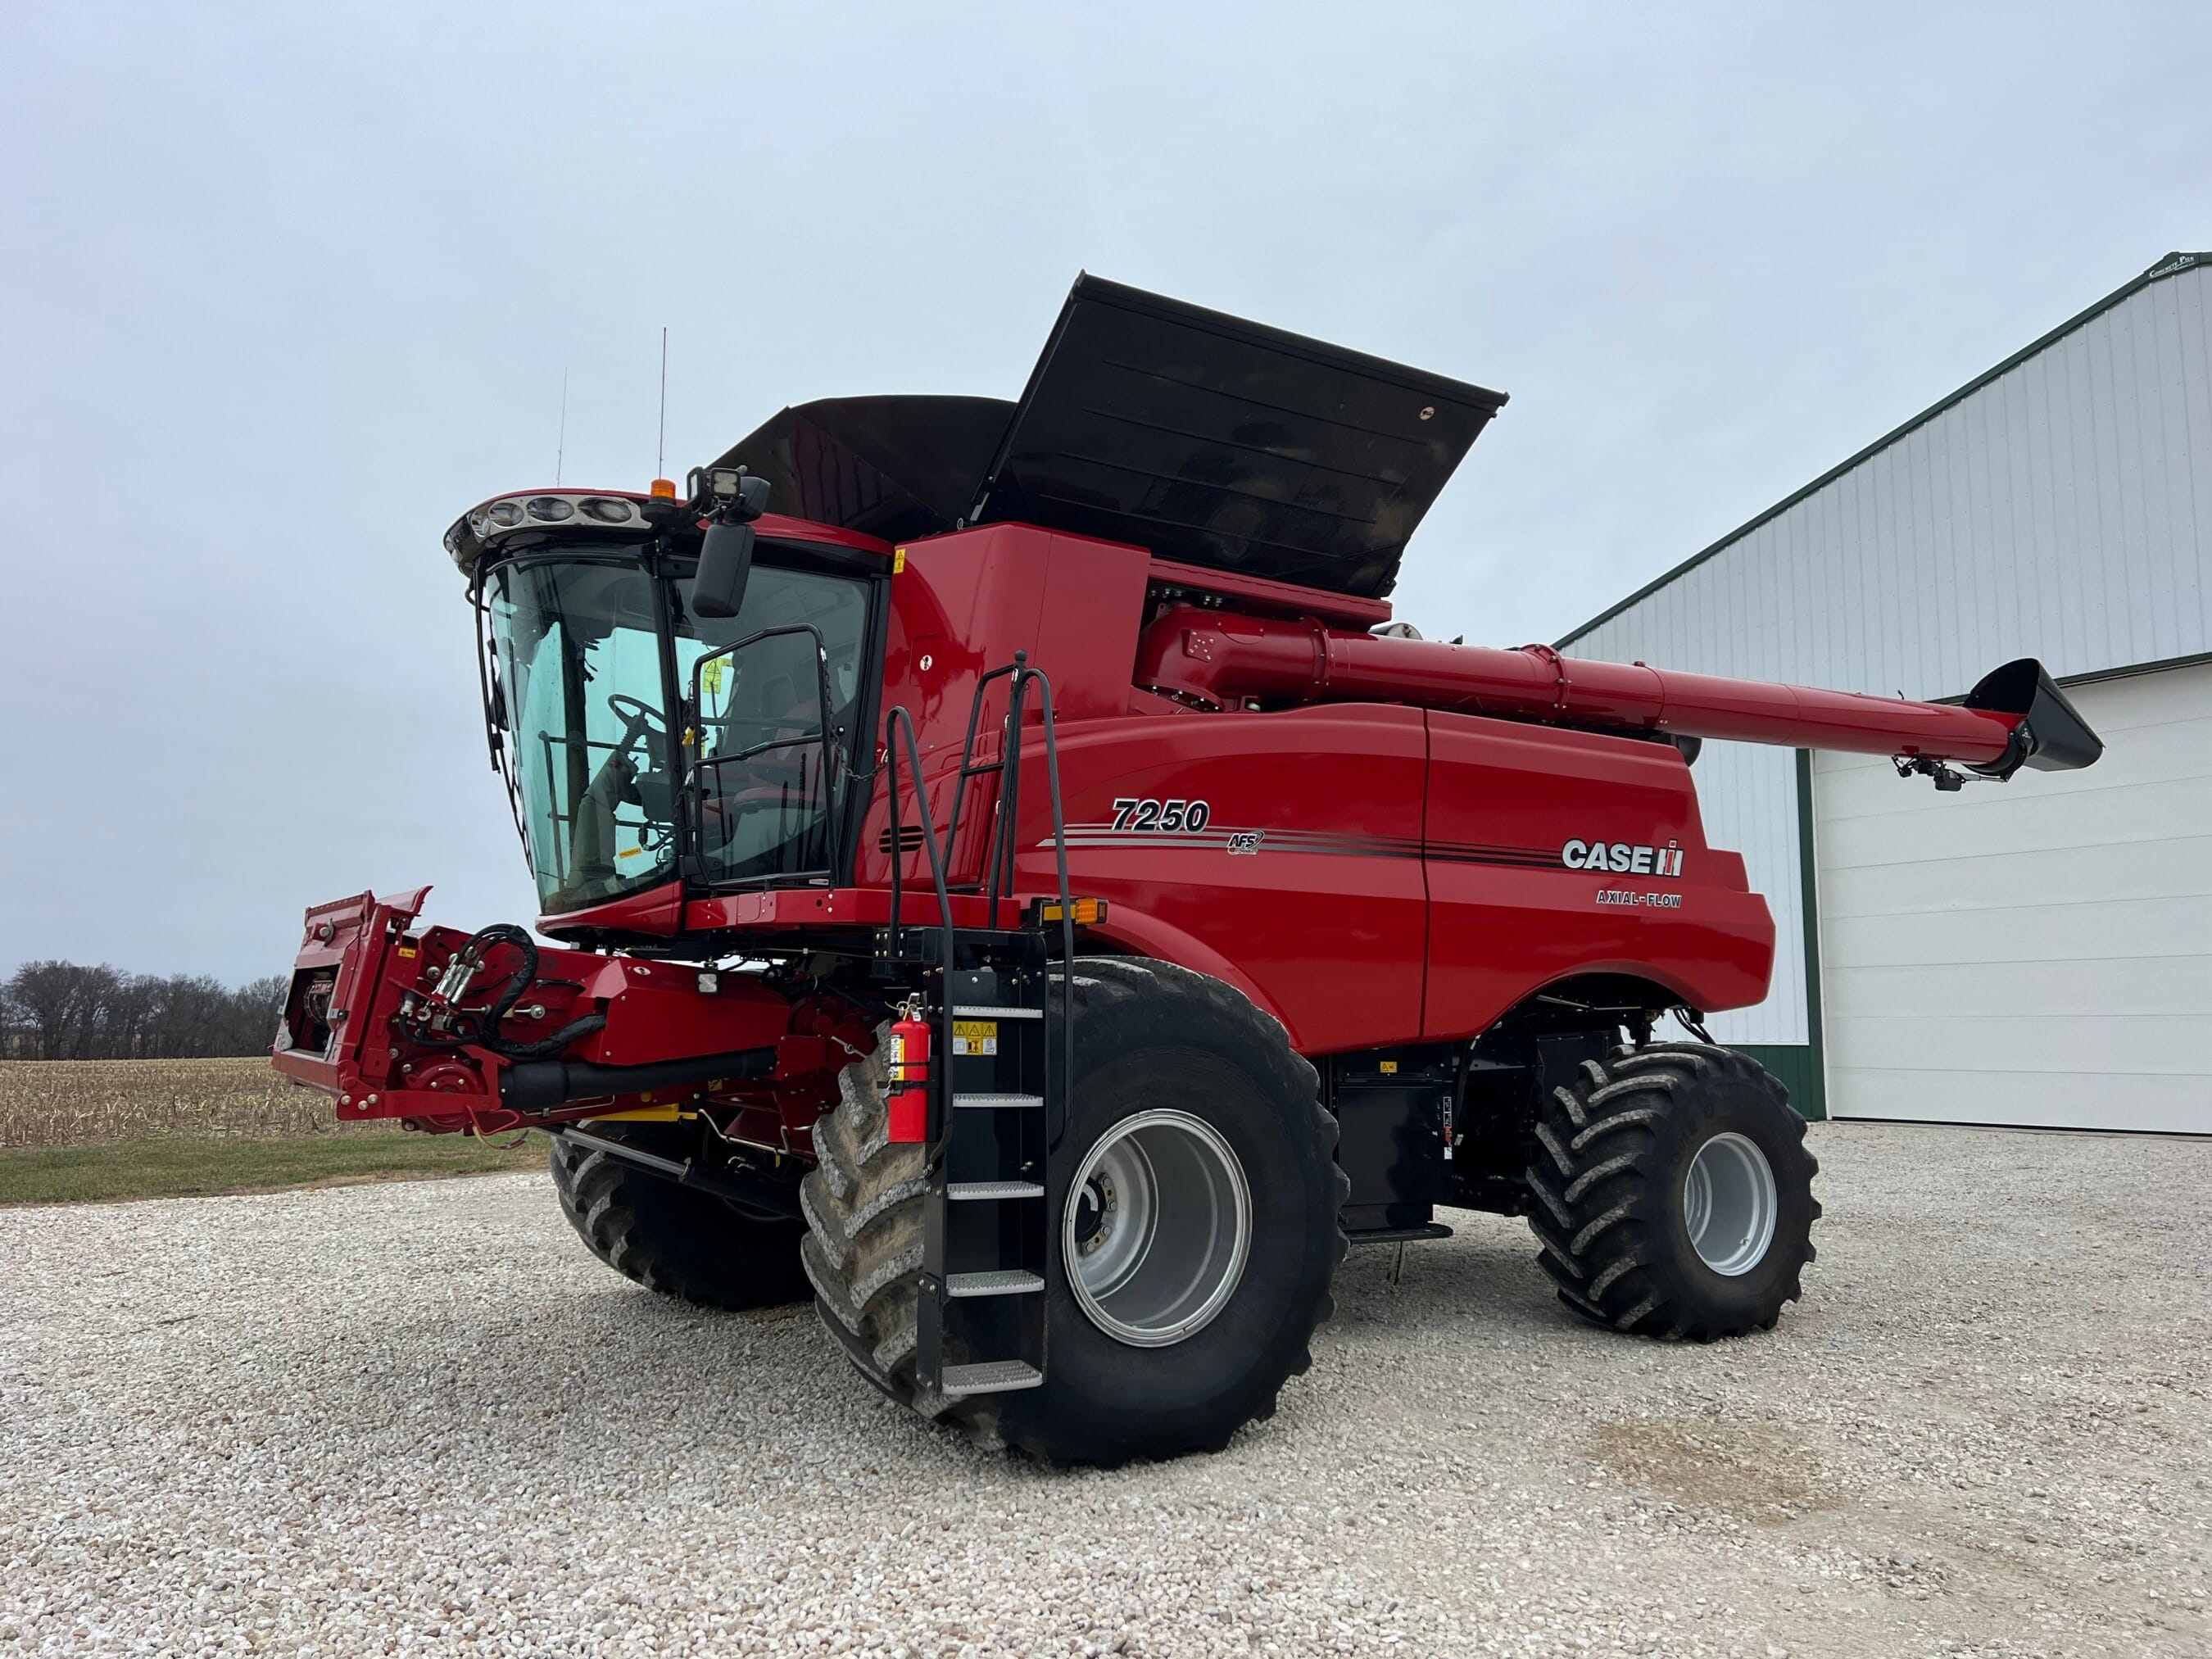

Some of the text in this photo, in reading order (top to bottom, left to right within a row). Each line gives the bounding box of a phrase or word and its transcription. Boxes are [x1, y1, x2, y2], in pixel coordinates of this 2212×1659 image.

[1112, 798, 1209, 832] 7250
[1226, 833, 1258, 848] AFS
[1562, 839, 1653, 873] CASE
[1596, 891, 1682, 908] AXIAL-FLOW
